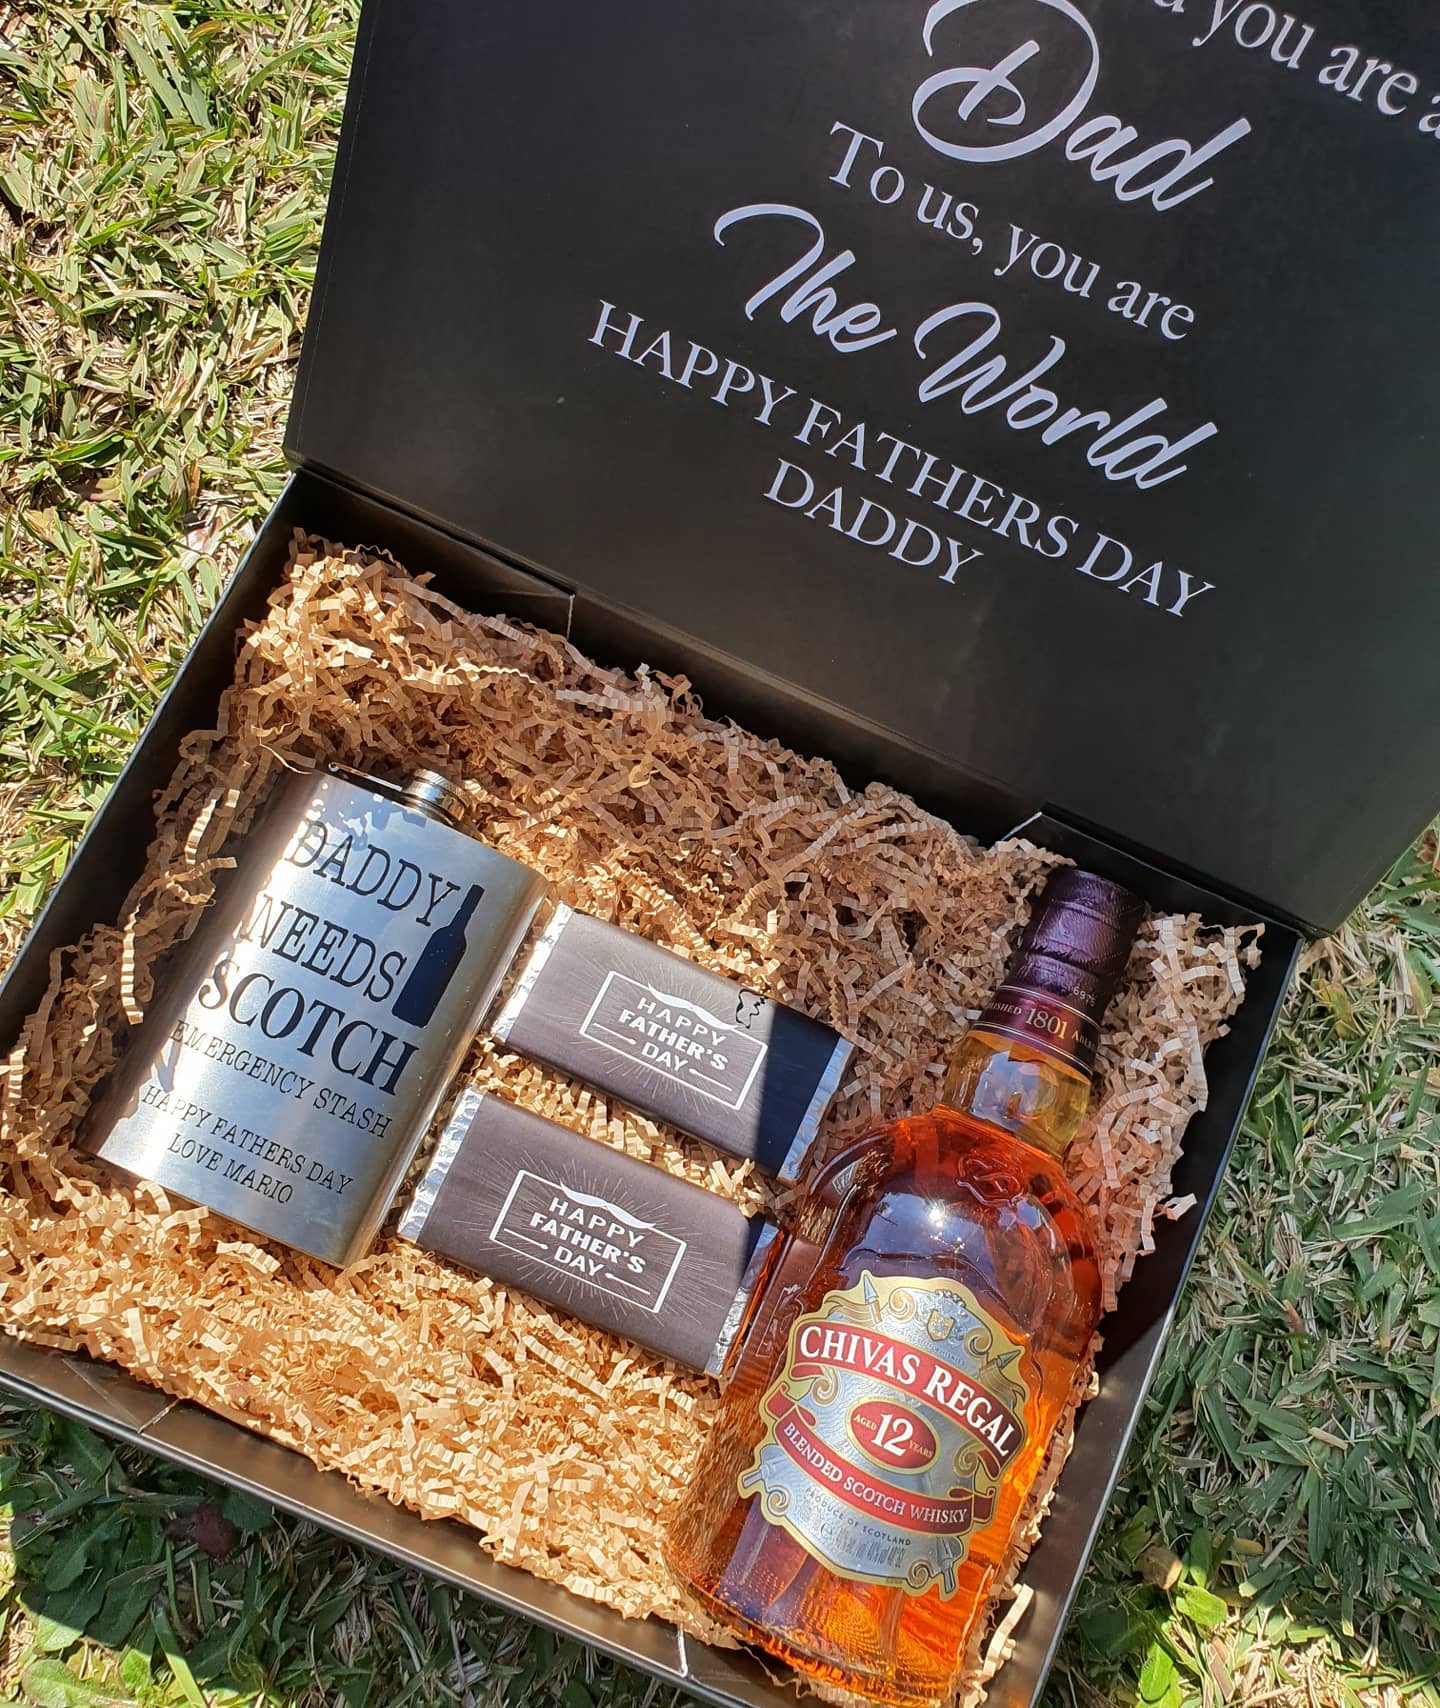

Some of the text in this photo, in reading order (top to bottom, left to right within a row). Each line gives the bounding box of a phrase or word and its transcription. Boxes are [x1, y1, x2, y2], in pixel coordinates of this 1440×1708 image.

[911, 0, 1251, 212] Dad
[1193, 0, 1314, 69] you
[1318, 47, 1418, 115] are
[828, 121, 1195, 340] To us, you are
[713, 203, 1218, 490] The World
[587, 299, 1215, 617] HAPPY FATHERS DAY
[763, 457, 984, 585] DADDY
[284, 818, 461, 927] DADDY
[239, 894, 408, 1003] NEEDS
[199, 958, 420, 1097] SCOTCH
[618, 1008, 729, 1071] FATHER'S
[637, 997, 727, 1046] HAPPY
[641, 1041, 689, 1072] DAY
[1025, 1007, 1068, 1039] 1801
[169, 1019, 393, 1139] EMERGENCY STASH
[141, 1085, 354, 1195] HAPPY FATHERS DAY
[167, 1132, 294, 1204] LOVE MARIO
[529, 1212, 647, 1273] FATHER'S
[549, 1197, 645, 1248] HAPPY
[554, 1245, 604, 1277] DAY
[799, 1325, 921, 1386] CHIVAS
[922, 1364, 1016, 1457] REGAL
[854, 1413, 934, 1459] AGED 12 YEARS
[783, 1422, 968, 1524] BLENDED SCOTCH WHISKY
[806, 1486, 911, 1546] PRODUCE OF SCOTLAND
